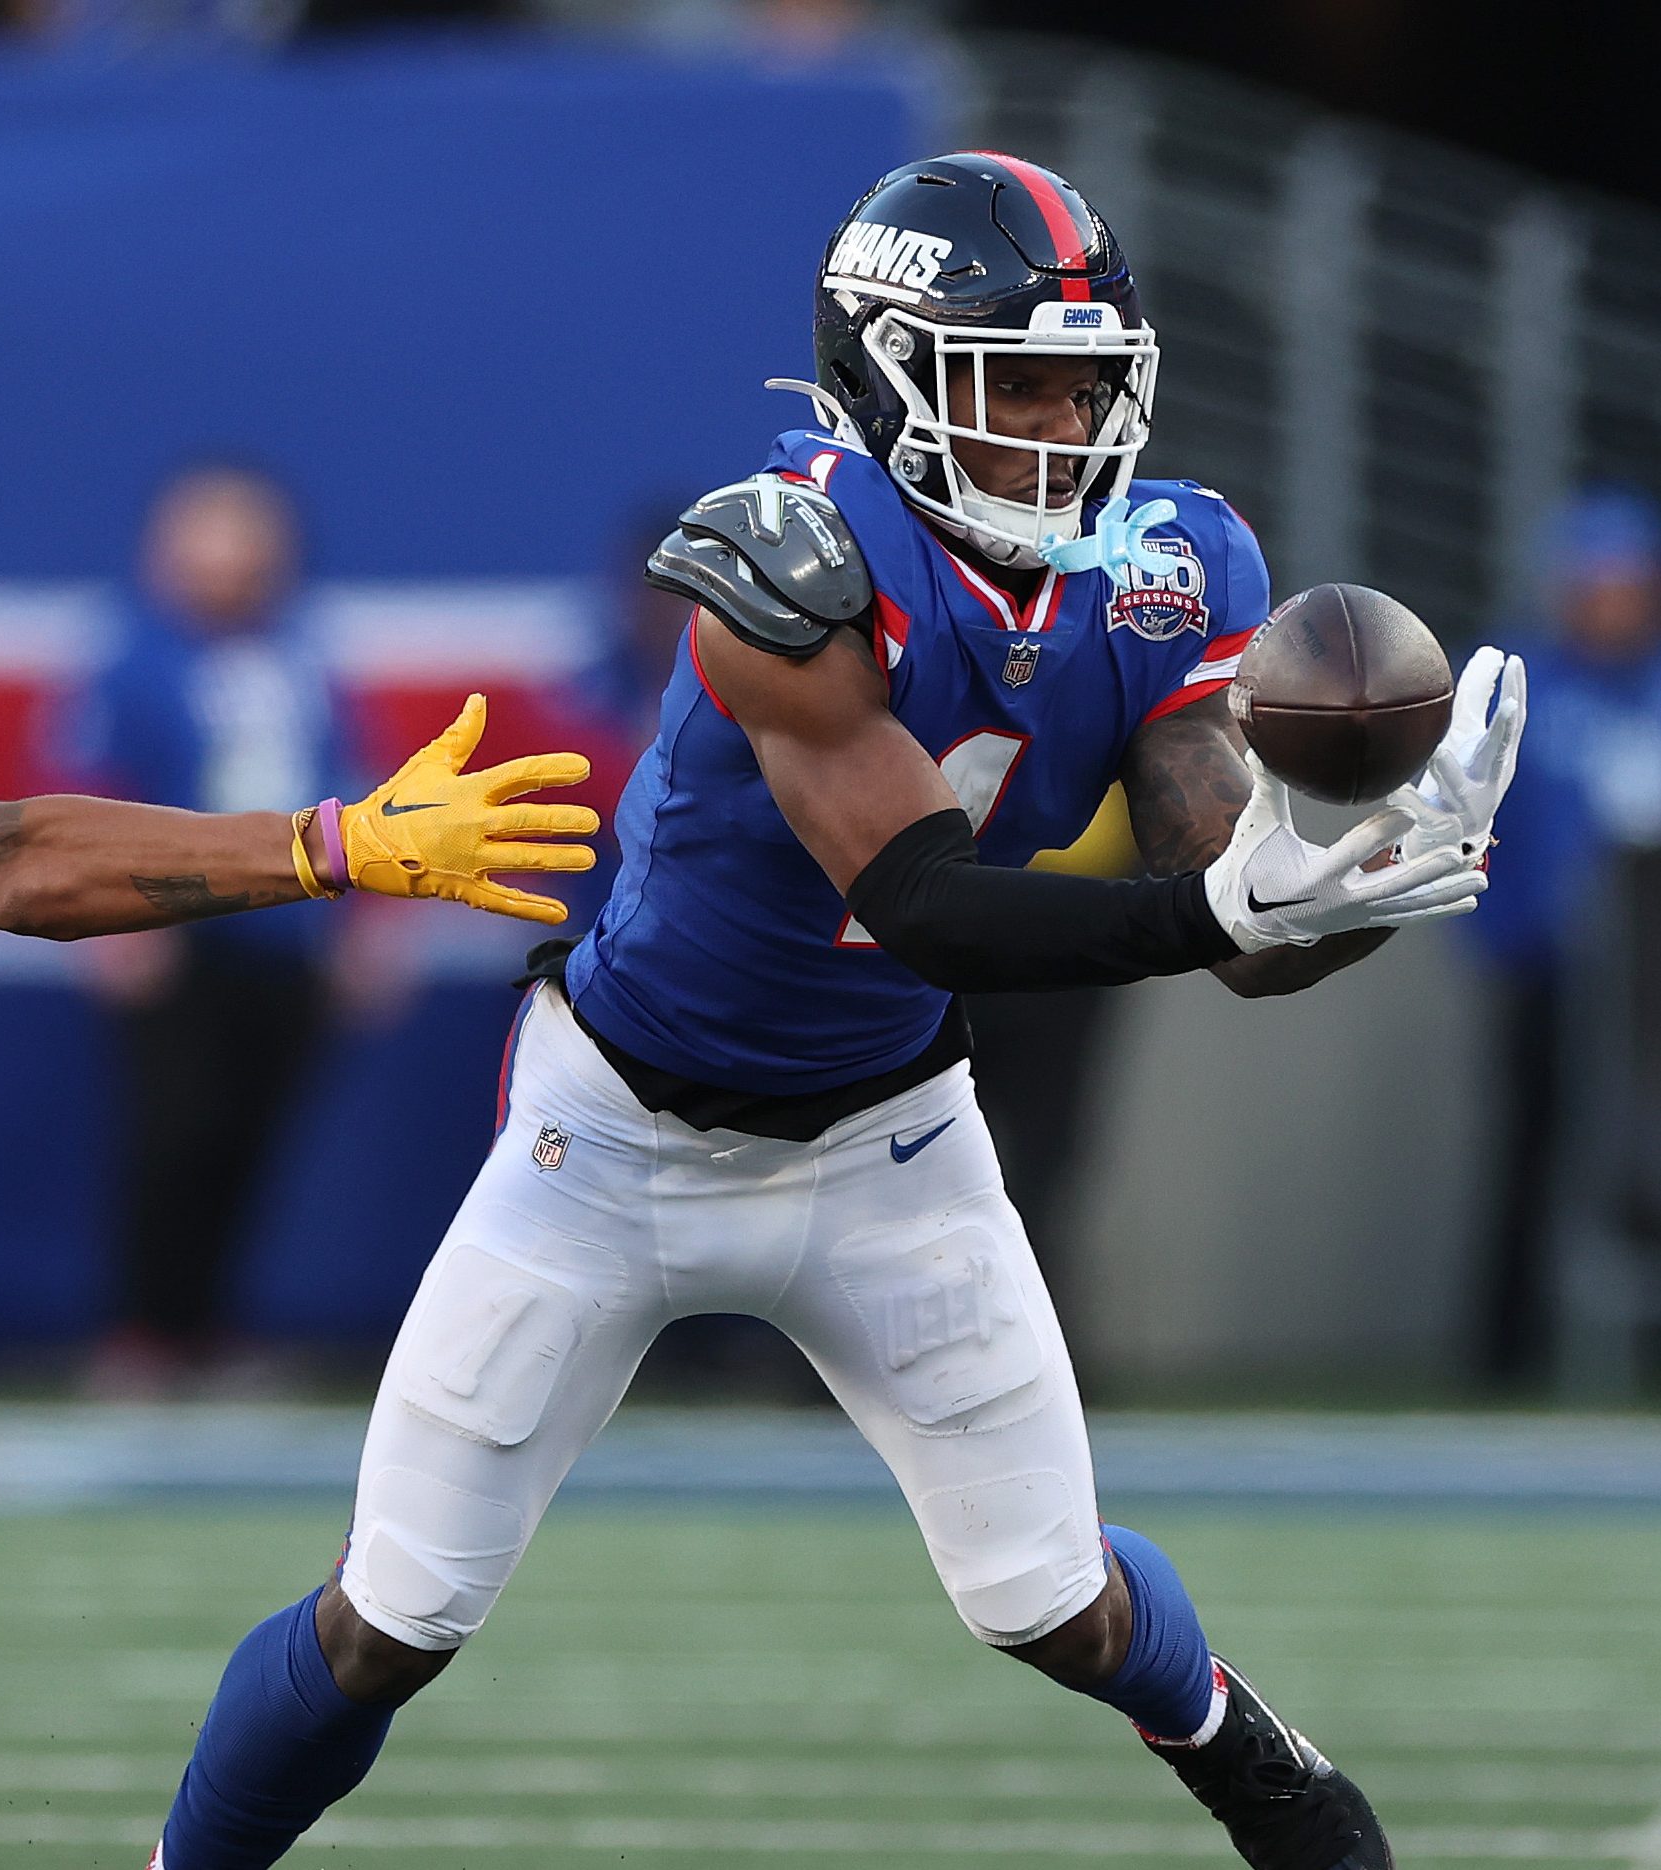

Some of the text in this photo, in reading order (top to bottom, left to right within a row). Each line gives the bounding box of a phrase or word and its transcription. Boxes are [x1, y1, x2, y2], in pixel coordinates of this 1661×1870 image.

[827, 221, 953, 290] GIANTS
[1063, 308, 1103, 325] GIANTS
[1123, 592, 1193, 610] SEASONS
